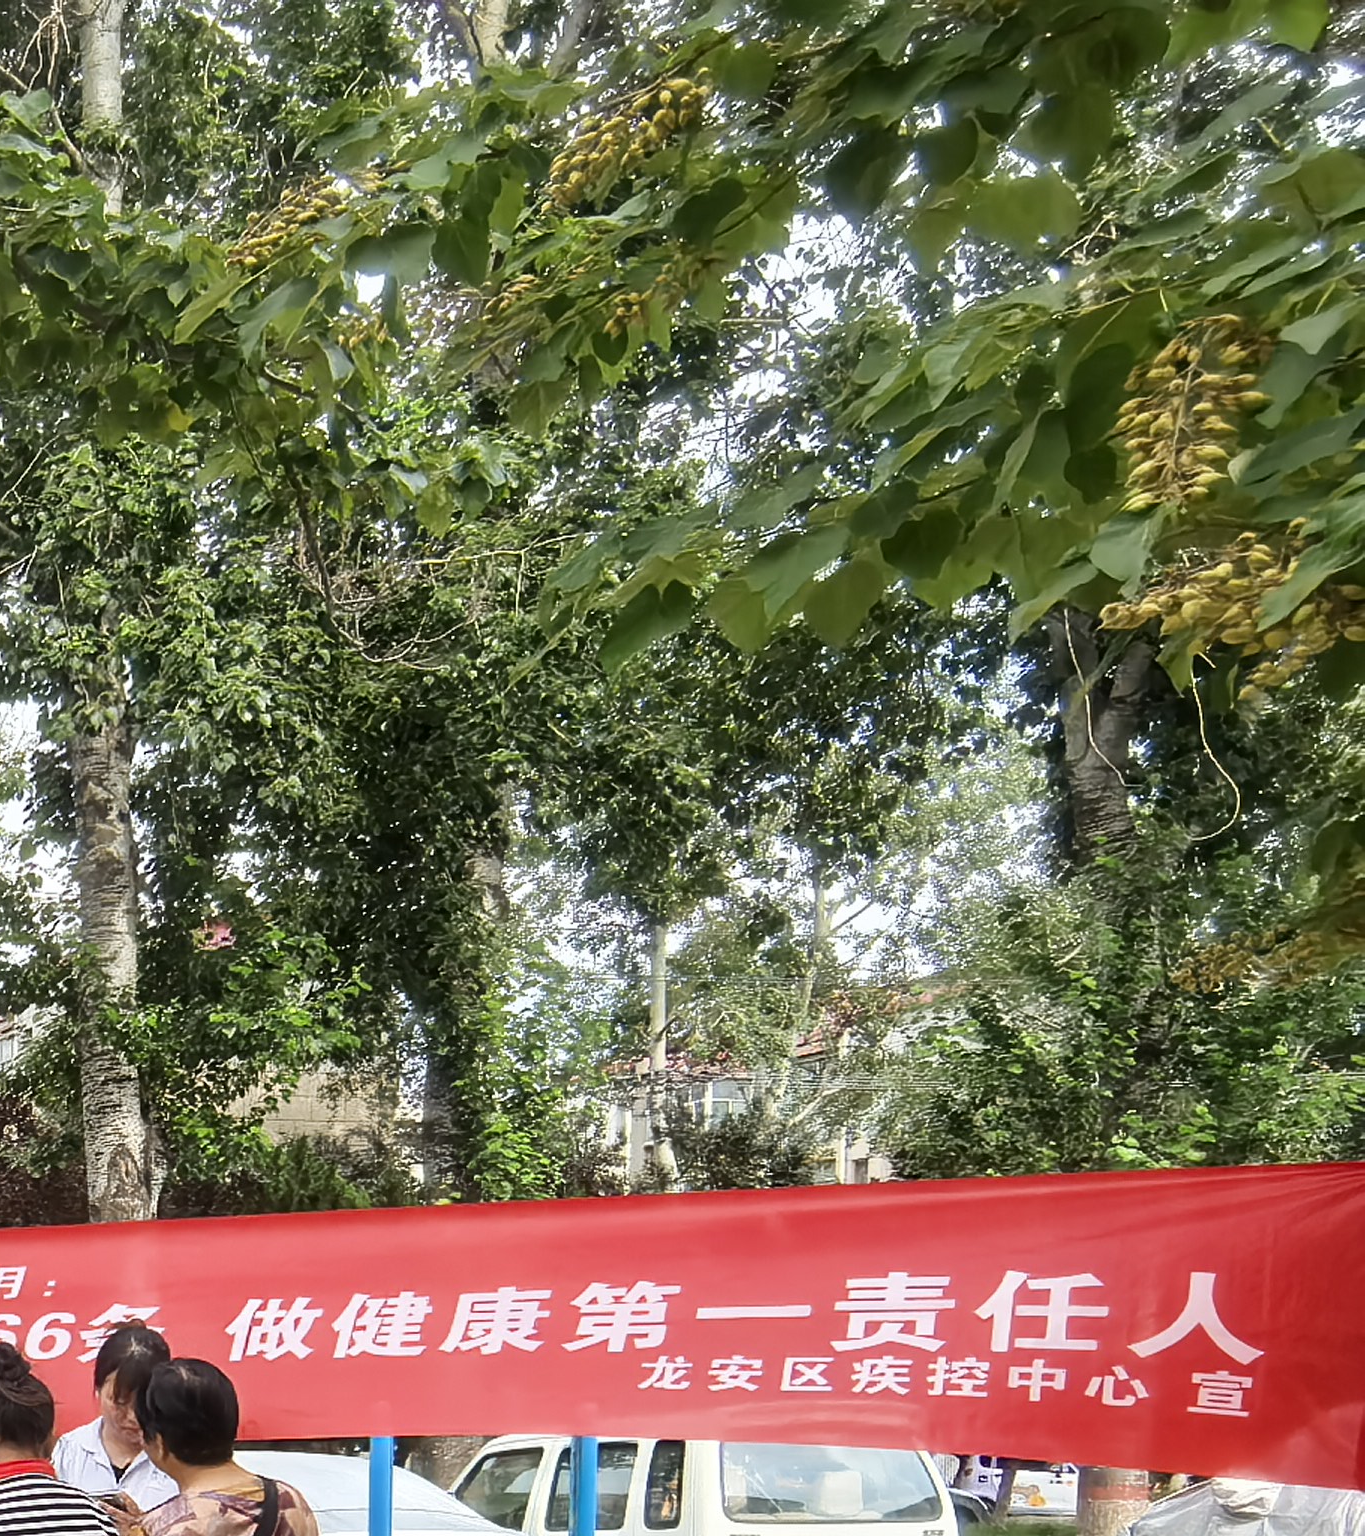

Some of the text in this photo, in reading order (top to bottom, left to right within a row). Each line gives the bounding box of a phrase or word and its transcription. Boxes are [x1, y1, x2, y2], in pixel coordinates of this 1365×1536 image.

[225, 1271, 1264, 1365] 做健康第一责任人
[637, 1354, 1253, 1417] 龙安区疾控中心 宣
